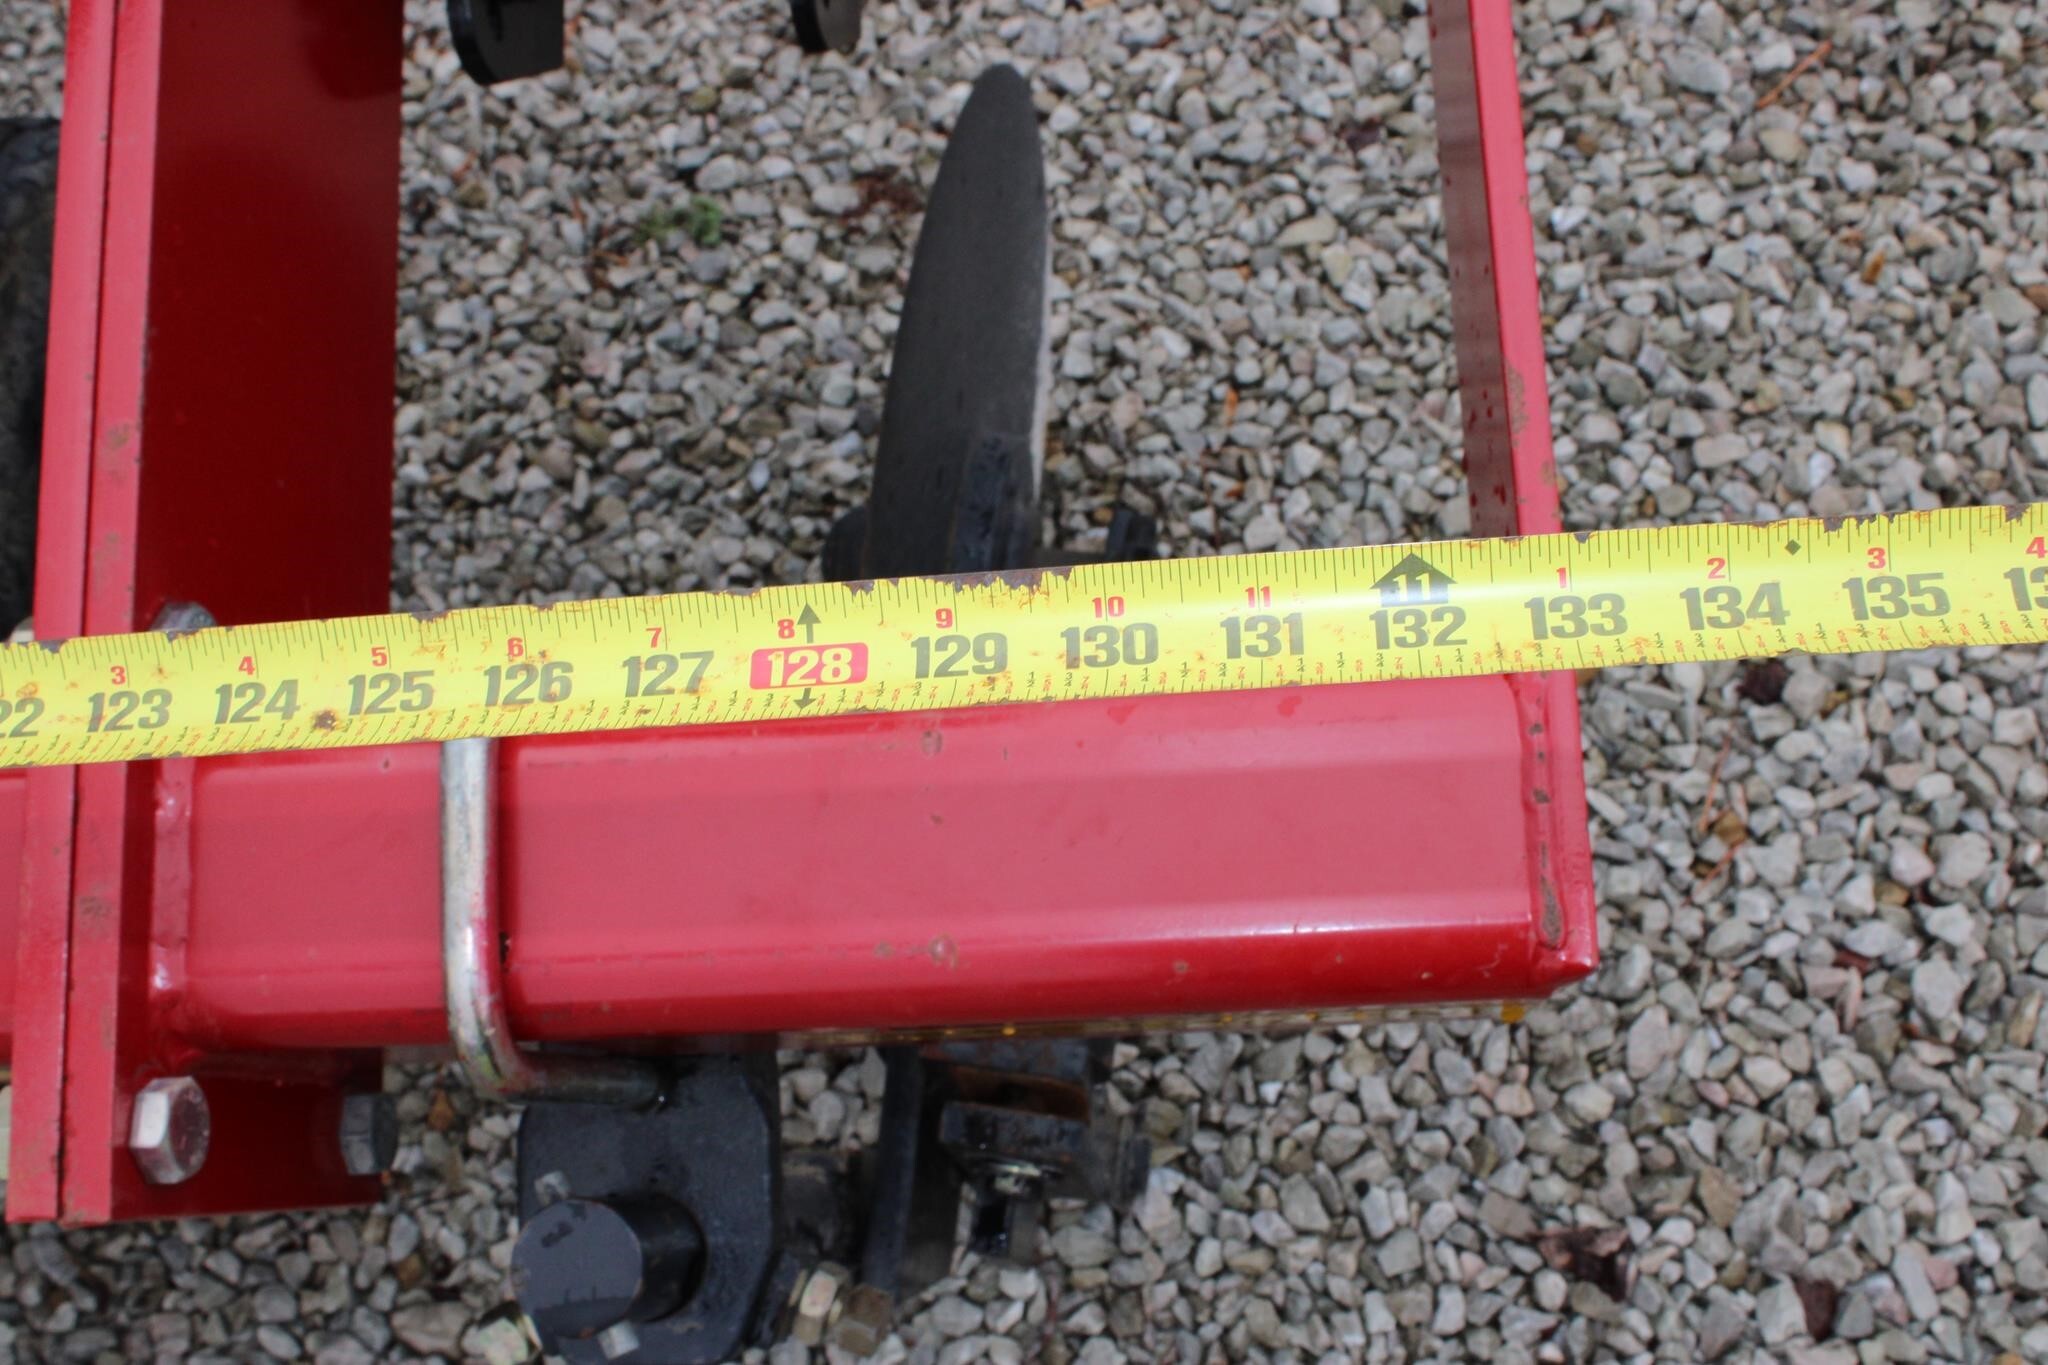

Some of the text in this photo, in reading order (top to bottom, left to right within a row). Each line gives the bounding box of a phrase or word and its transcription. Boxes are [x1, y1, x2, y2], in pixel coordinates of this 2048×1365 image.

[87, 688, 173, 733] 123
[214, 679, 300, 725] 124
[348, 669, 436, 716] 125
[483, 660, 574, 707] 126
[622, 650, 714, 698] 127
[767, 647, 853, 687] 128
[911, 632, 1008, 679] 129
[1060, 622, 1158, 669] 130
[1219, 612, 1304, 660] 131
[1369, 606, 1468, 650] 132
[1524, 592, 1628, 641] 133
[1679, 581, 1790, 630] 134
[1842, 572, 1952, 621] 135
[111, 536, 2048, 685] 3 4 5 6 7 8 9 10 11 1 2 3 4
[1394, 573, 1431, 602] 11
